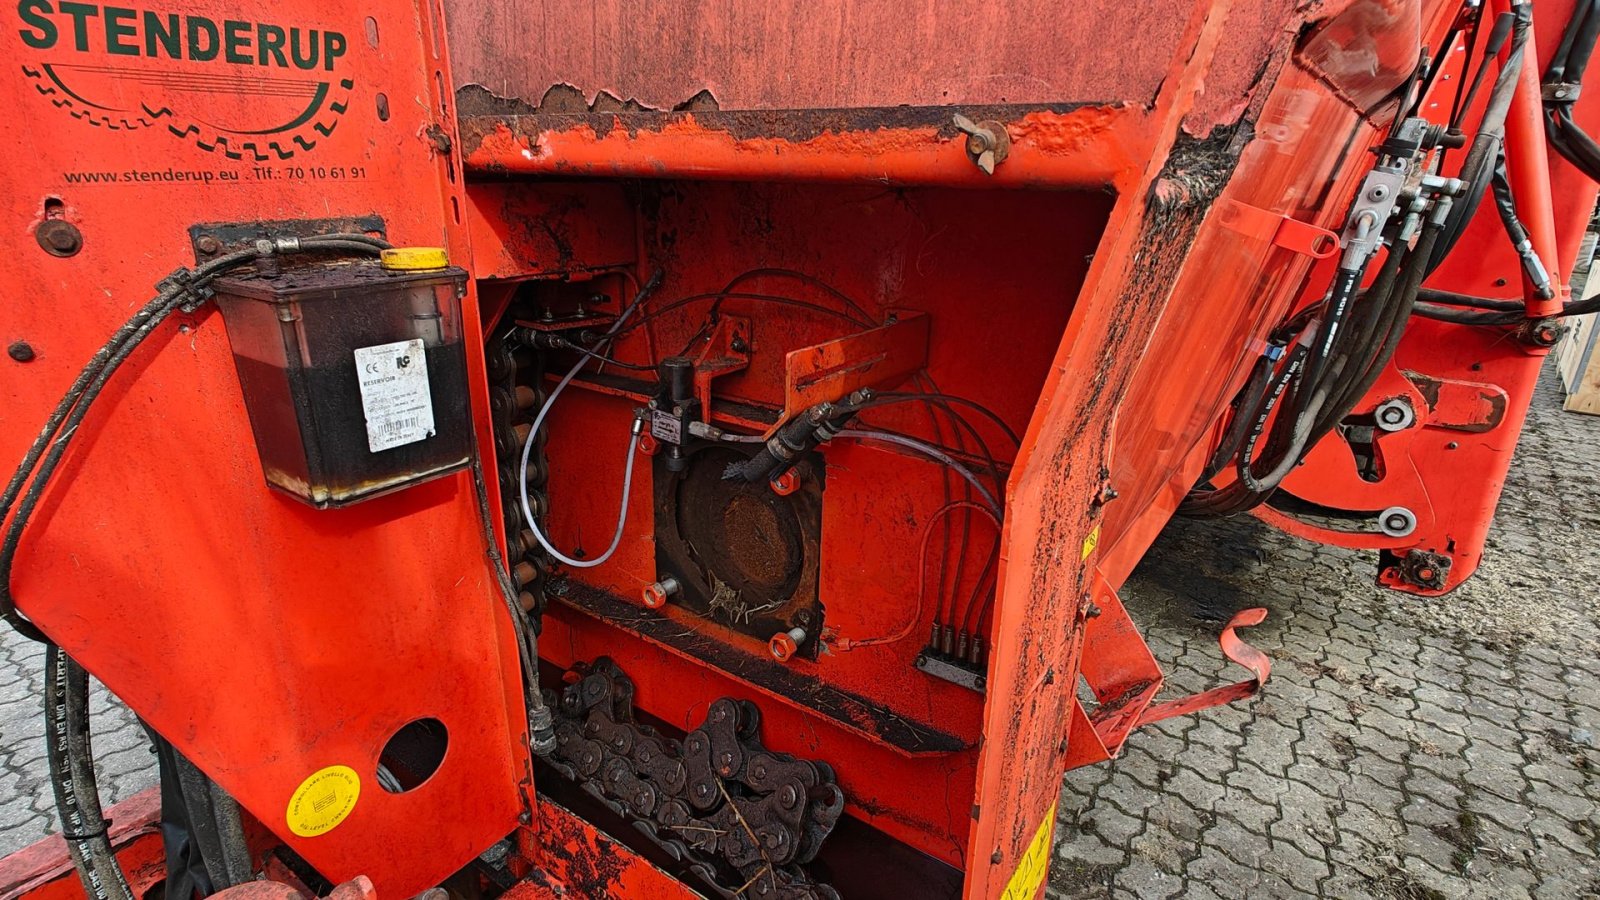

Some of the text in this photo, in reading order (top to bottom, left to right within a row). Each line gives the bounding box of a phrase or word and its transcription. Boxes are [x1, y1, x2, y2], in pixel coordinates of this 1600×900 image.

[17, 0, 347, 71] STENDERUP
[64, 167, 367, 185] www.stenderup.eu Tlf.: 70 10 61 91
[1289, 361, 1300, 374] DIN
[363, 375, 396, 387] RESERVOIR
[1281, 373, 1292, 385] EN
[56, 703, 66, 721] DIN
[57, 722, 67, 735] EN
[63, 779, 73, 794] DN
[66, 794, 76, 806] 10
[70, 810, 81, 826] WP
[79, 842, 92, 862] BAR
